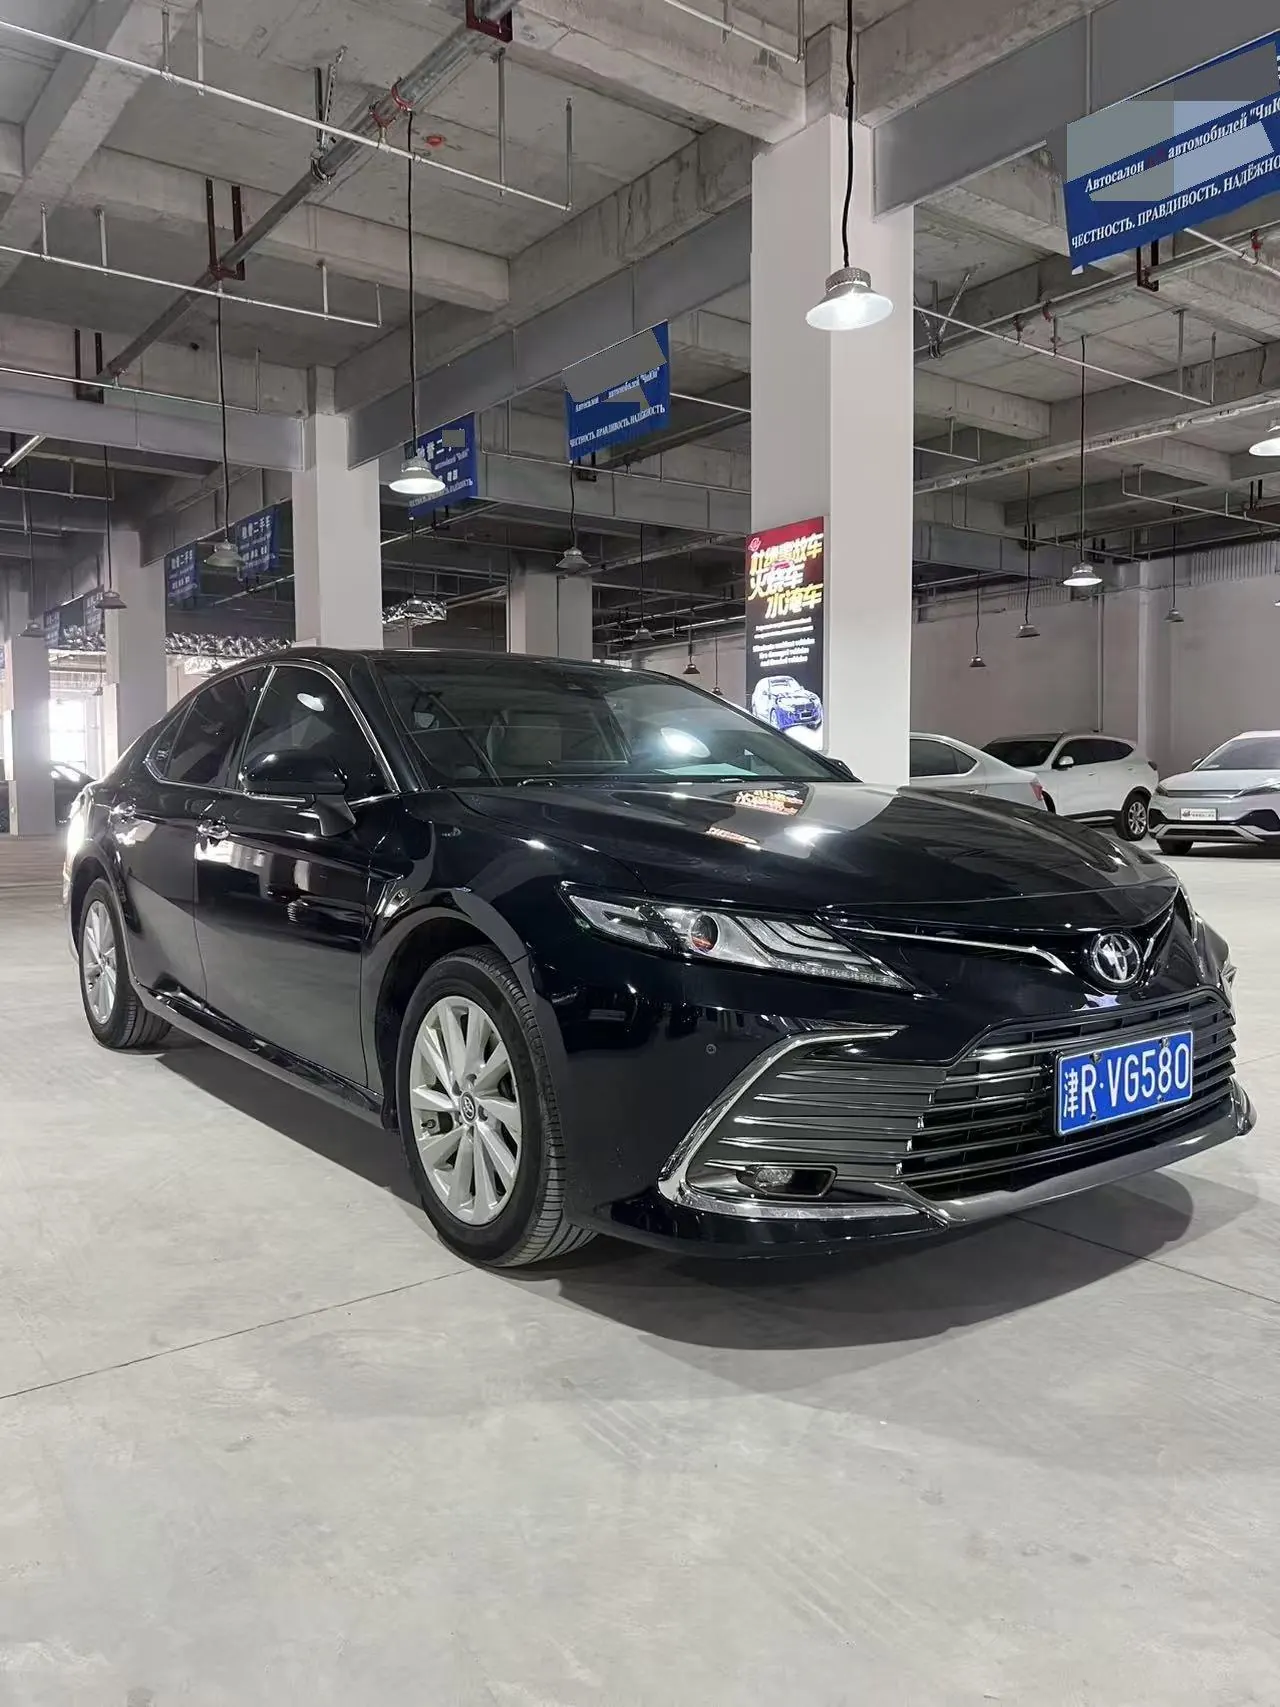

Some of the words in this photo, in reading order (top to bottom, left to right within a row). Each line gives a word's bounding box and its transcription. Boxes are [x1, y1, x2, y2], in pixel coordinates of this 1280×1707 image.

[1085, 160, 1144, 193] Автосалон
[1168, 112, 1248, 159] автомобилей
[1071, 217, 1136, 249] ЧЕСТНОСТЬ.
[1138, 183, 1221, 226] ПРАВДИВОСТЬ.
